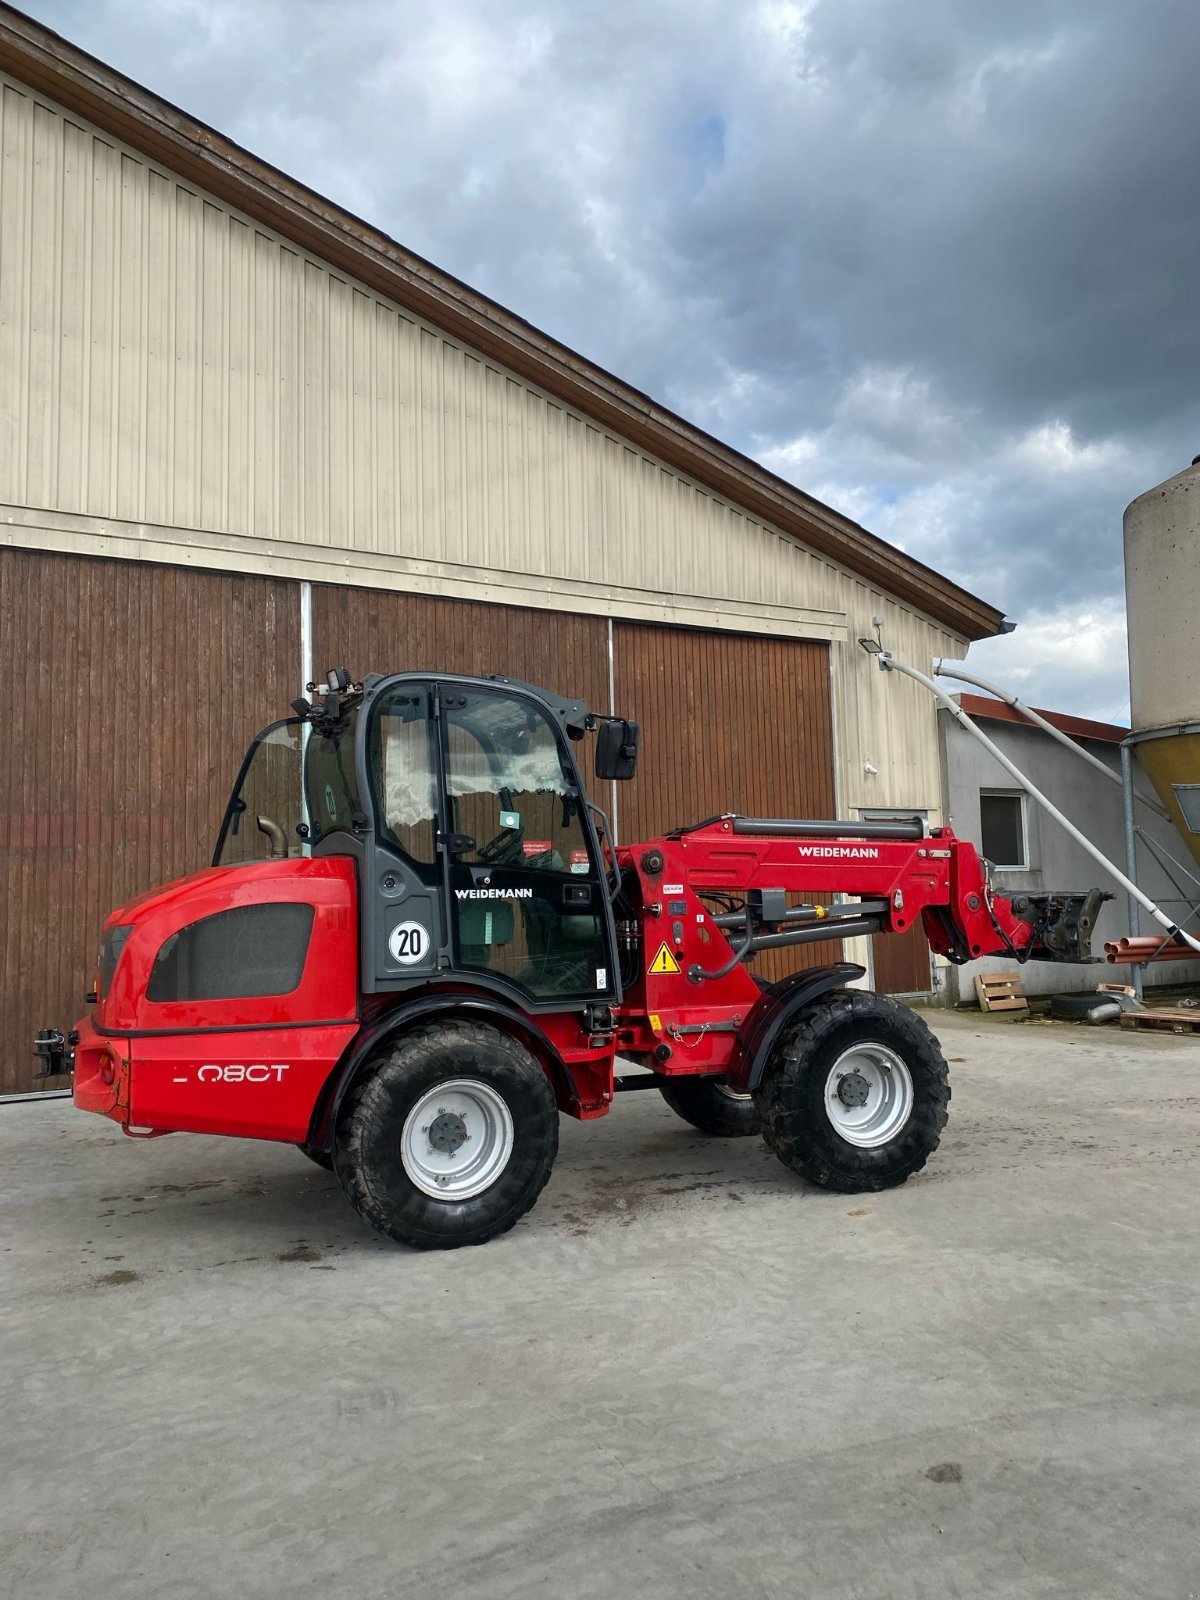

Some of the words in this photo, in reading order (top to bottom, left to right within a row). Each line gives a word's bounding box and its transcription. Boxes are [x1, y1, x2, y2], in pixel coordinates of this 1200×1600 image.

[798, 846, 879, 858] WEIDEMANN
[454, 888, 533, 899] WEIDEMANN
[398, 929, 421, 956] 20
